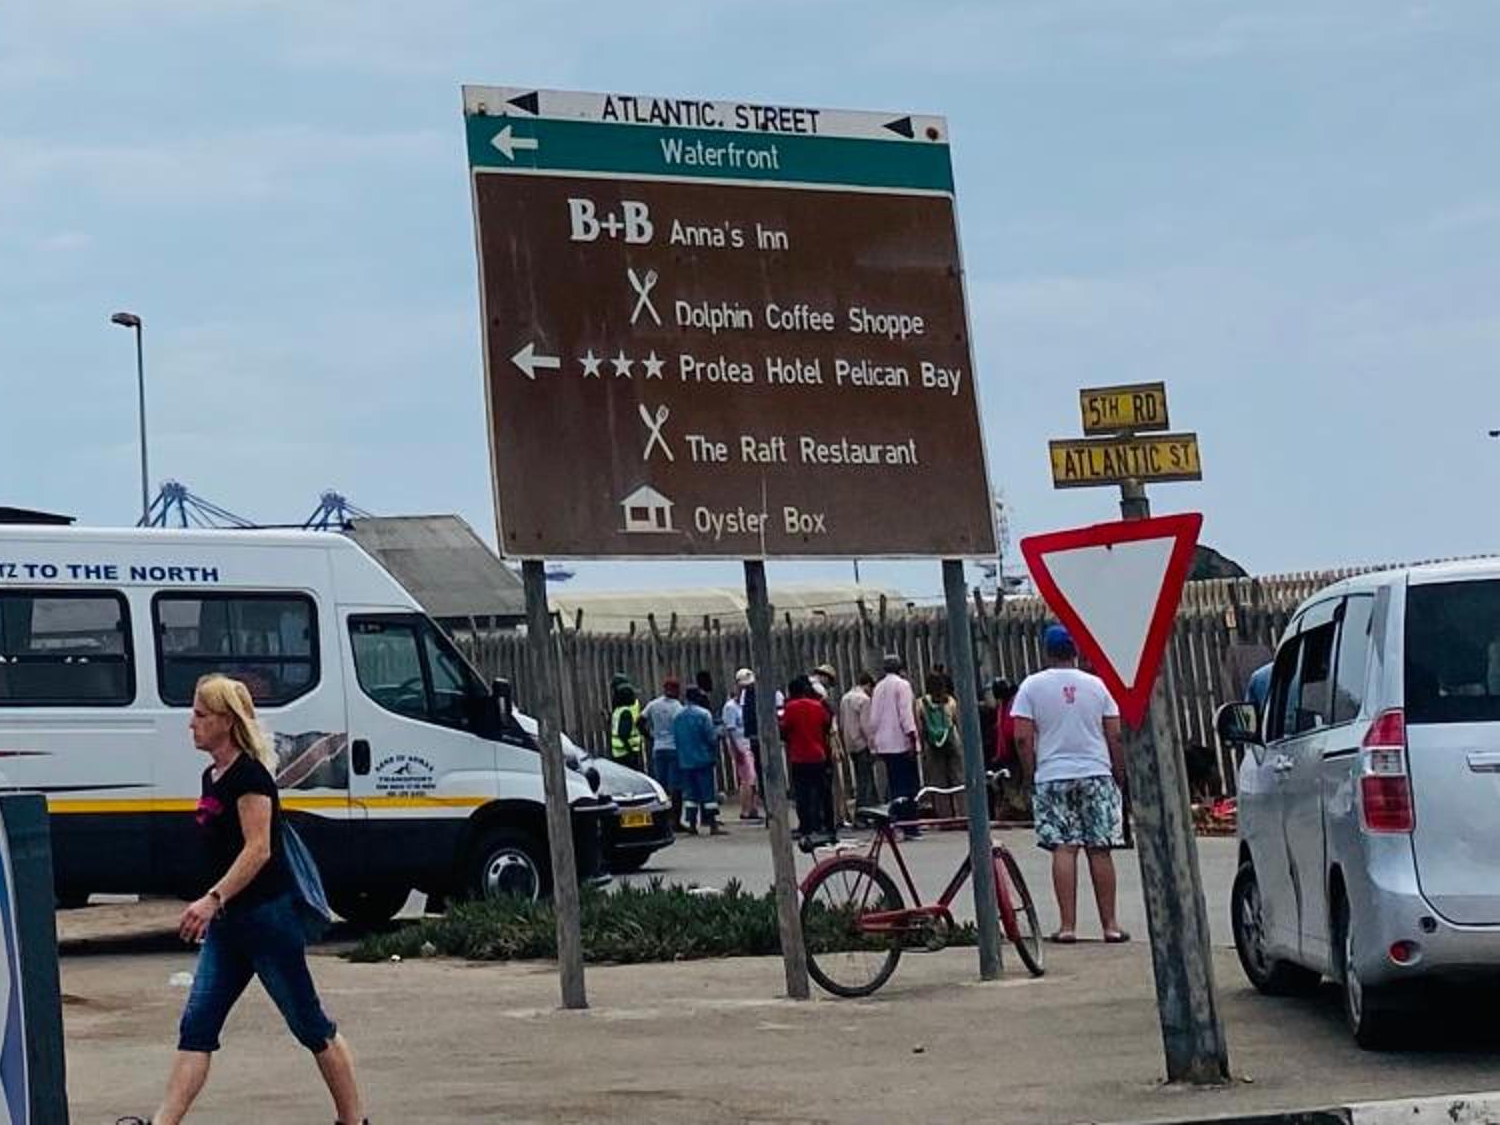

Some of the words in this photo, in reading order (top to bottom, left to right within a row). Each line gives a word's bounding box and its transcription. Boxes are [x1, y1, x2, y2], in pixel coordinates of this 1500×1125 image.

[735, 105, 820, 133] STREET
[660, 138, 779, 169] Waterfront
[567, 198, 653, 244] B+B
[669, 219, 744, 248] Anna's
[756, 223, 789, 250] Inn
[675, 300, 753, 334] Dolphin
[765, 303, 835, 331] Coffee
[848, 307, 925, 339] Shoppe
[679, 354, 754, 383] Protea
[766, 356, 823, 385] Hotel
[835, 359, 909, 386] Pelican
[920, 361, 961, 395] Bay
[1088, 396, 1119, 425] 5TH
[1133, 393, 1157, 422] RD
[685, 435, 728, 462] The
[740, 436, 788, 463] Raft
[800, 437, 919, 465] Restaurant
[1064, 446, 1162, 478] ATLANTIC
[1169, 443, 1190, 466] ST
[694, 506, 767, 542] Oyster
[783, 507, 828, 534] Box
[23, 564, 59, 578] TO
[67, 564, 118, 580] THE
[129, 565, 219, 582] NORTH
